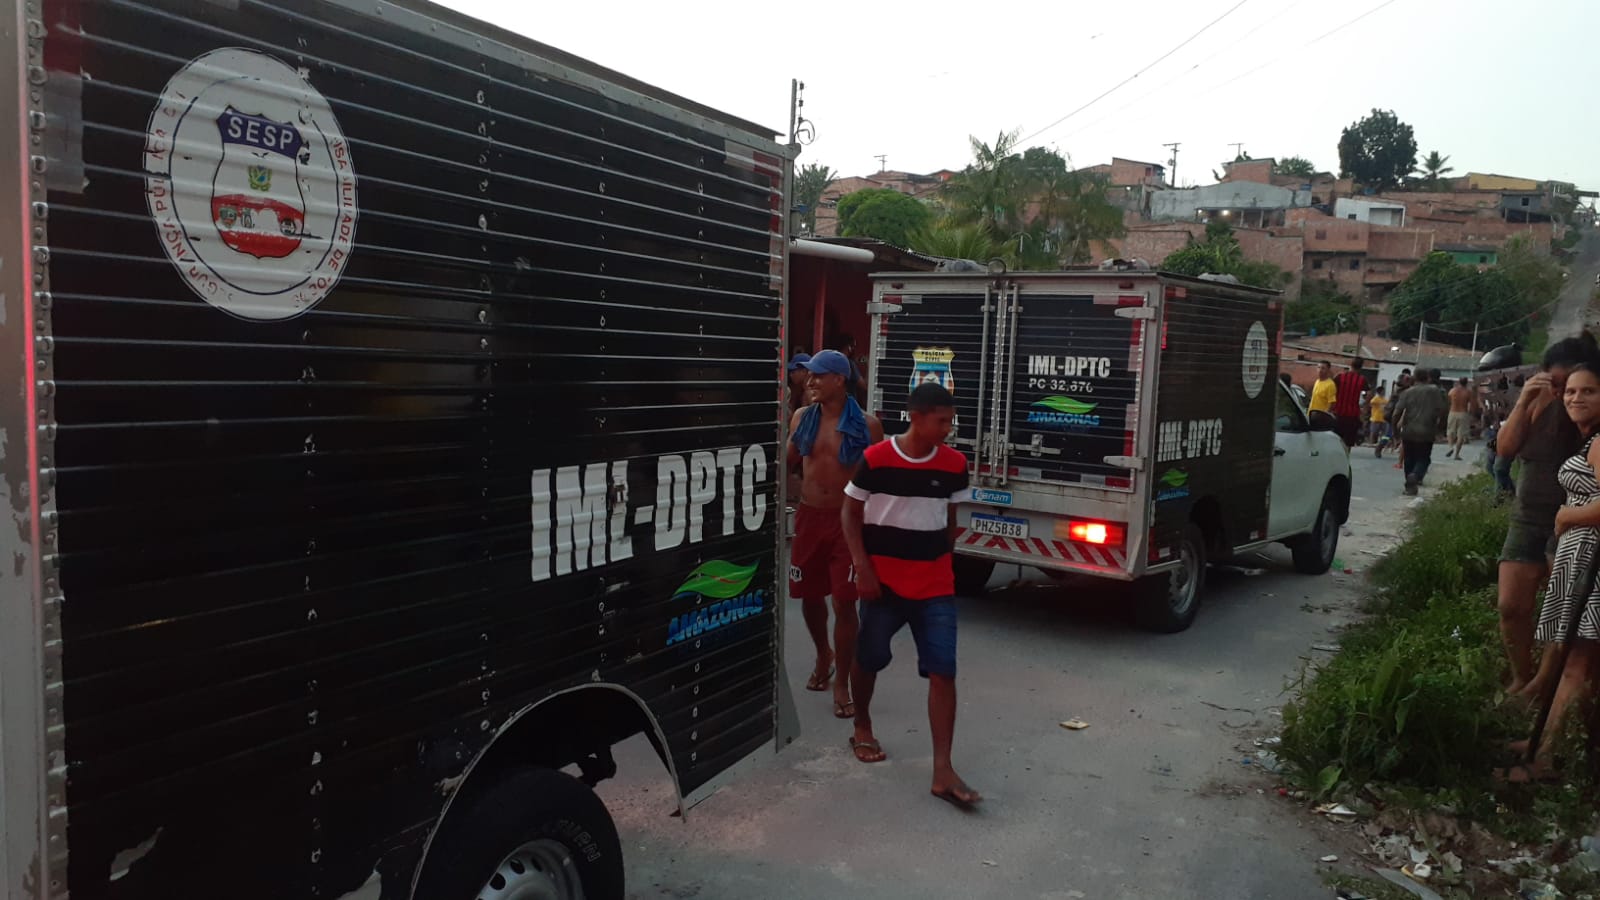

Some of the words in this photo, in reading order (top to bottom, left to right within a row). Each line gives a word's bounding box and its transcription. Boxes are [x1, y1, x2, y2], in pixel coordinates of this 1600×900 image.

[228, 116, 293, 149] SESP
[1028, 355, 1111, 378] IML-DPTC
[1028, 378, 1046, 389] PC
[1027, 411, 1100, 426] AMAZONAS
[1157, 417, 1223, 462] IML-DPTC
[531, 443, 767, 582] IML-DPTC
[975, 520, 1022, 537] PHZ5B38
[665, 588, 765, 646] AMAZONAS
